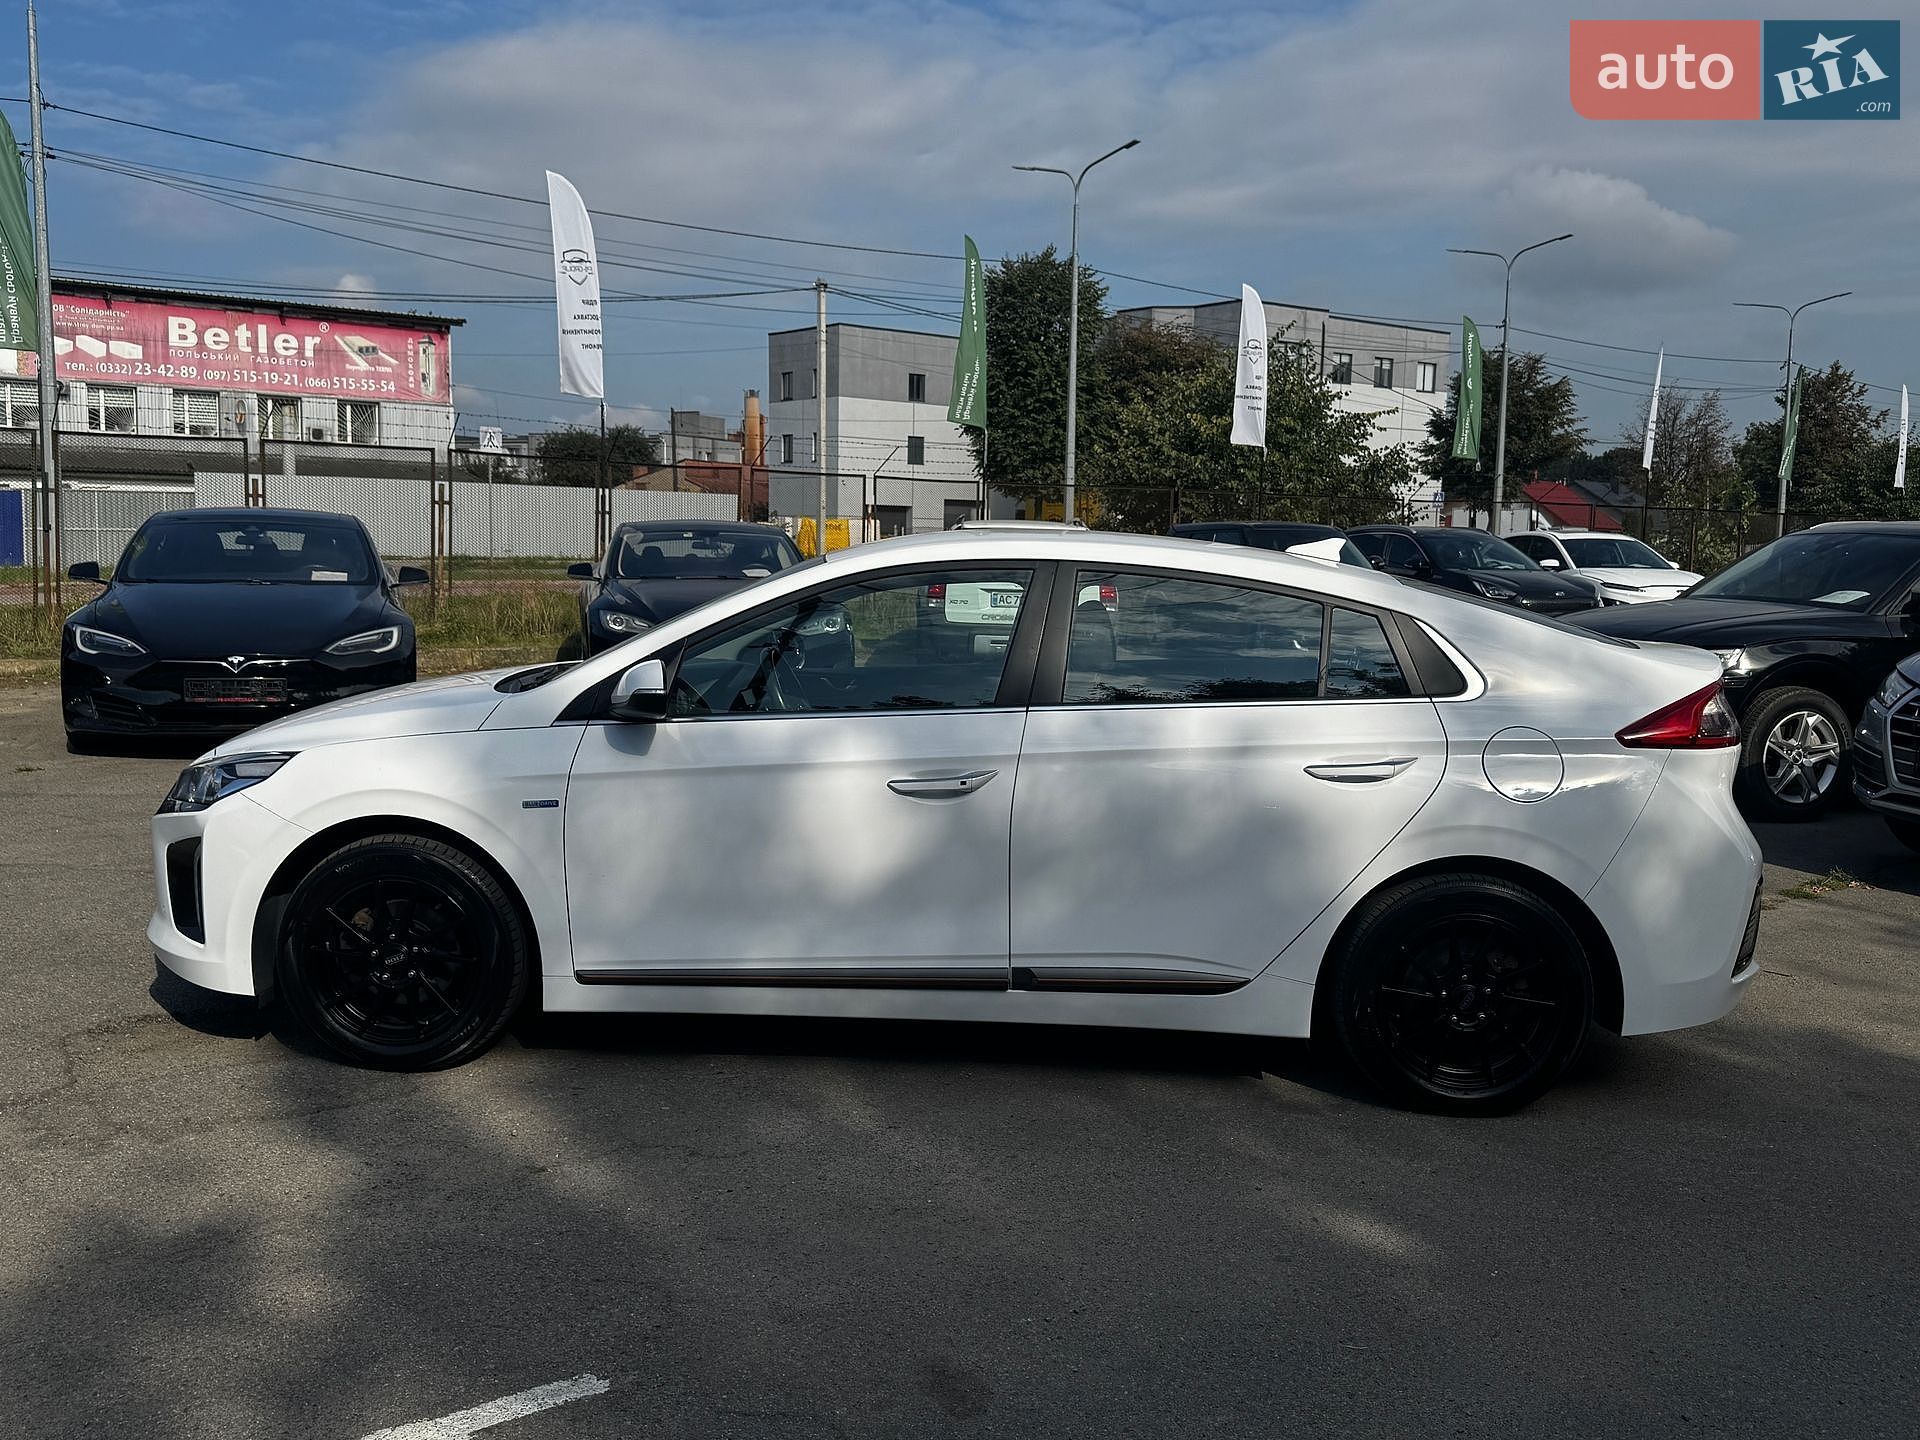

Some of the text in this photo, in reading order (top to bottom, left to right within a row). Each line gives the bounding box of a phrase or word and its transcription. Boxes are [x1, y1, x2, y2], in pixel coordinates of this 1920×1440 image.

[52, 303, 64, 313] ОВ
[168, 316, 322, 358] Betler
[65, 361, 93, 372] тел.:
[95, 361, 132, 373] (0332)
[203, 369, 231, 382] (097)
[305, 376, 331, 390] (066)
[333, 376, 396, 393] 515-55-54
